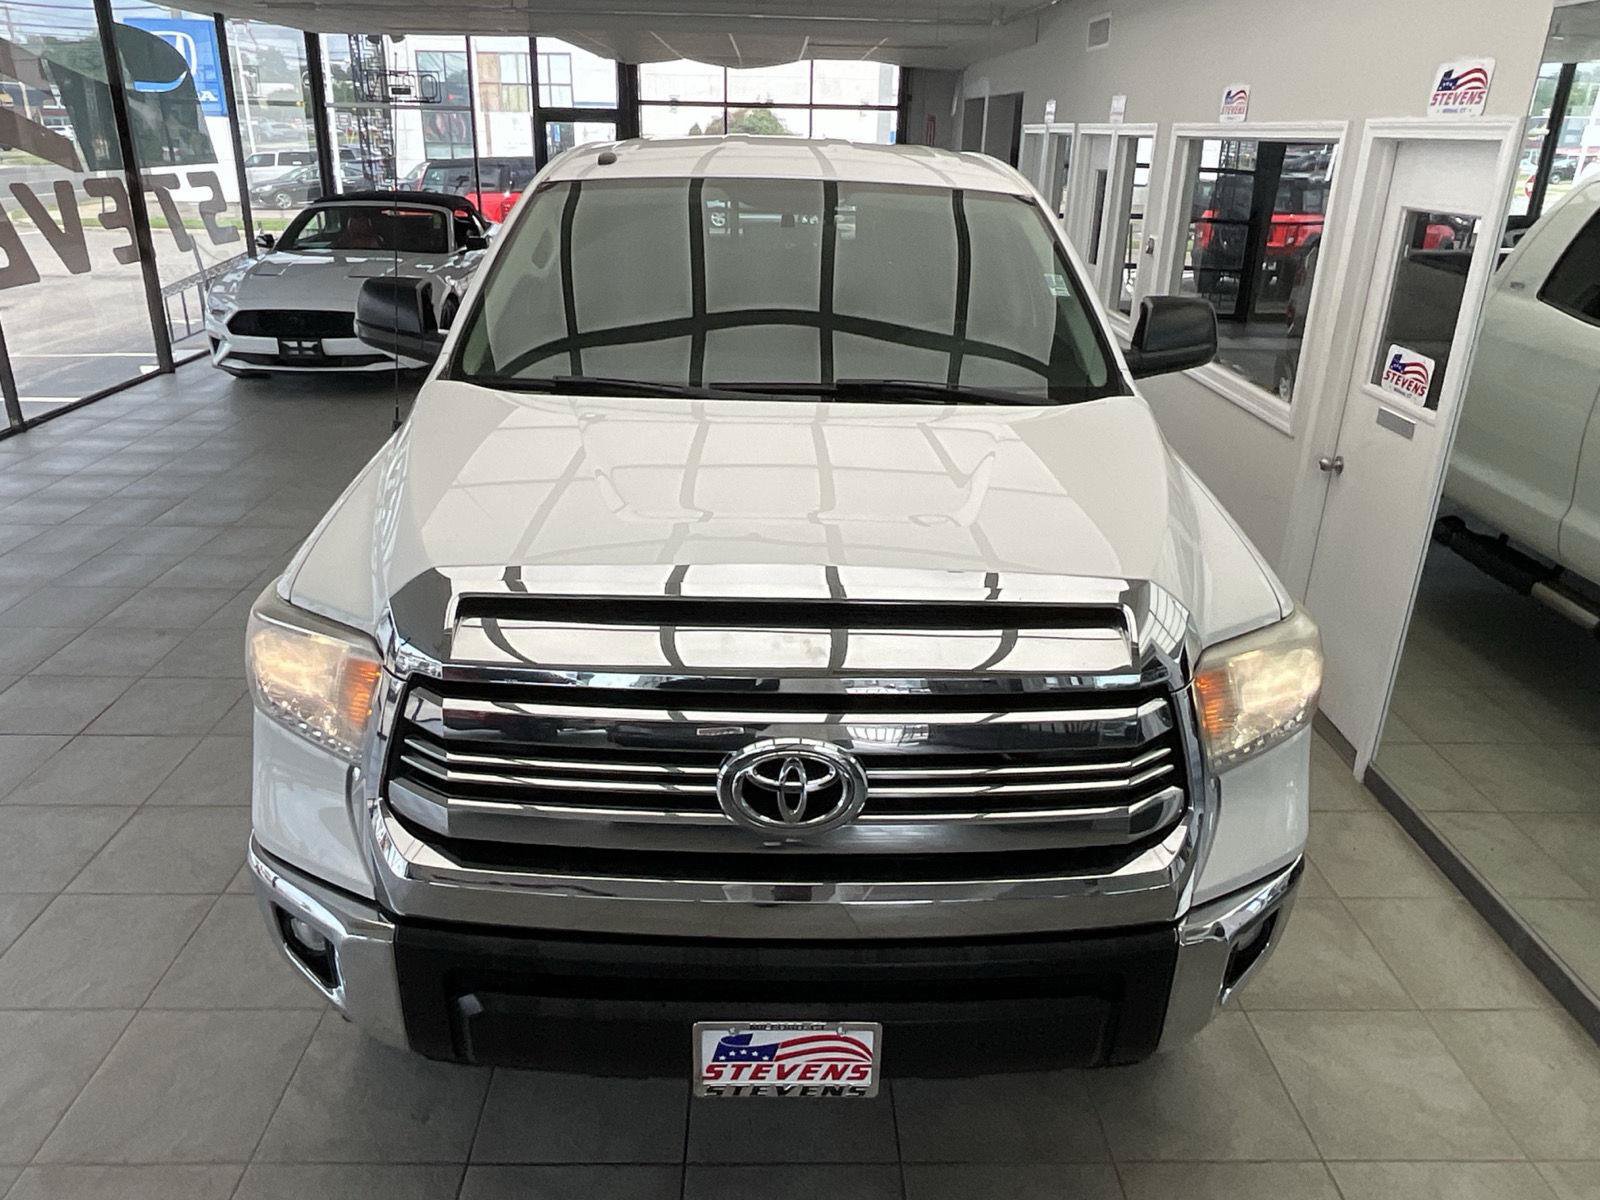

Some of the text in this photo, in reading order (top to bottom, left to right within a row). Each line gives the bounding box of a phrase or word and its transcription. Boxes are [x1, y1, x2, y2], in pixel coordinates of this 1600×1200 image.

[1430, 91, 1487, 107] STEVENS
[1383, 370, 1427, 397] STEVENS
[702, 1063, 873, 1081] STEVENS
[704, 1085, 868, 1097] STEVENS
